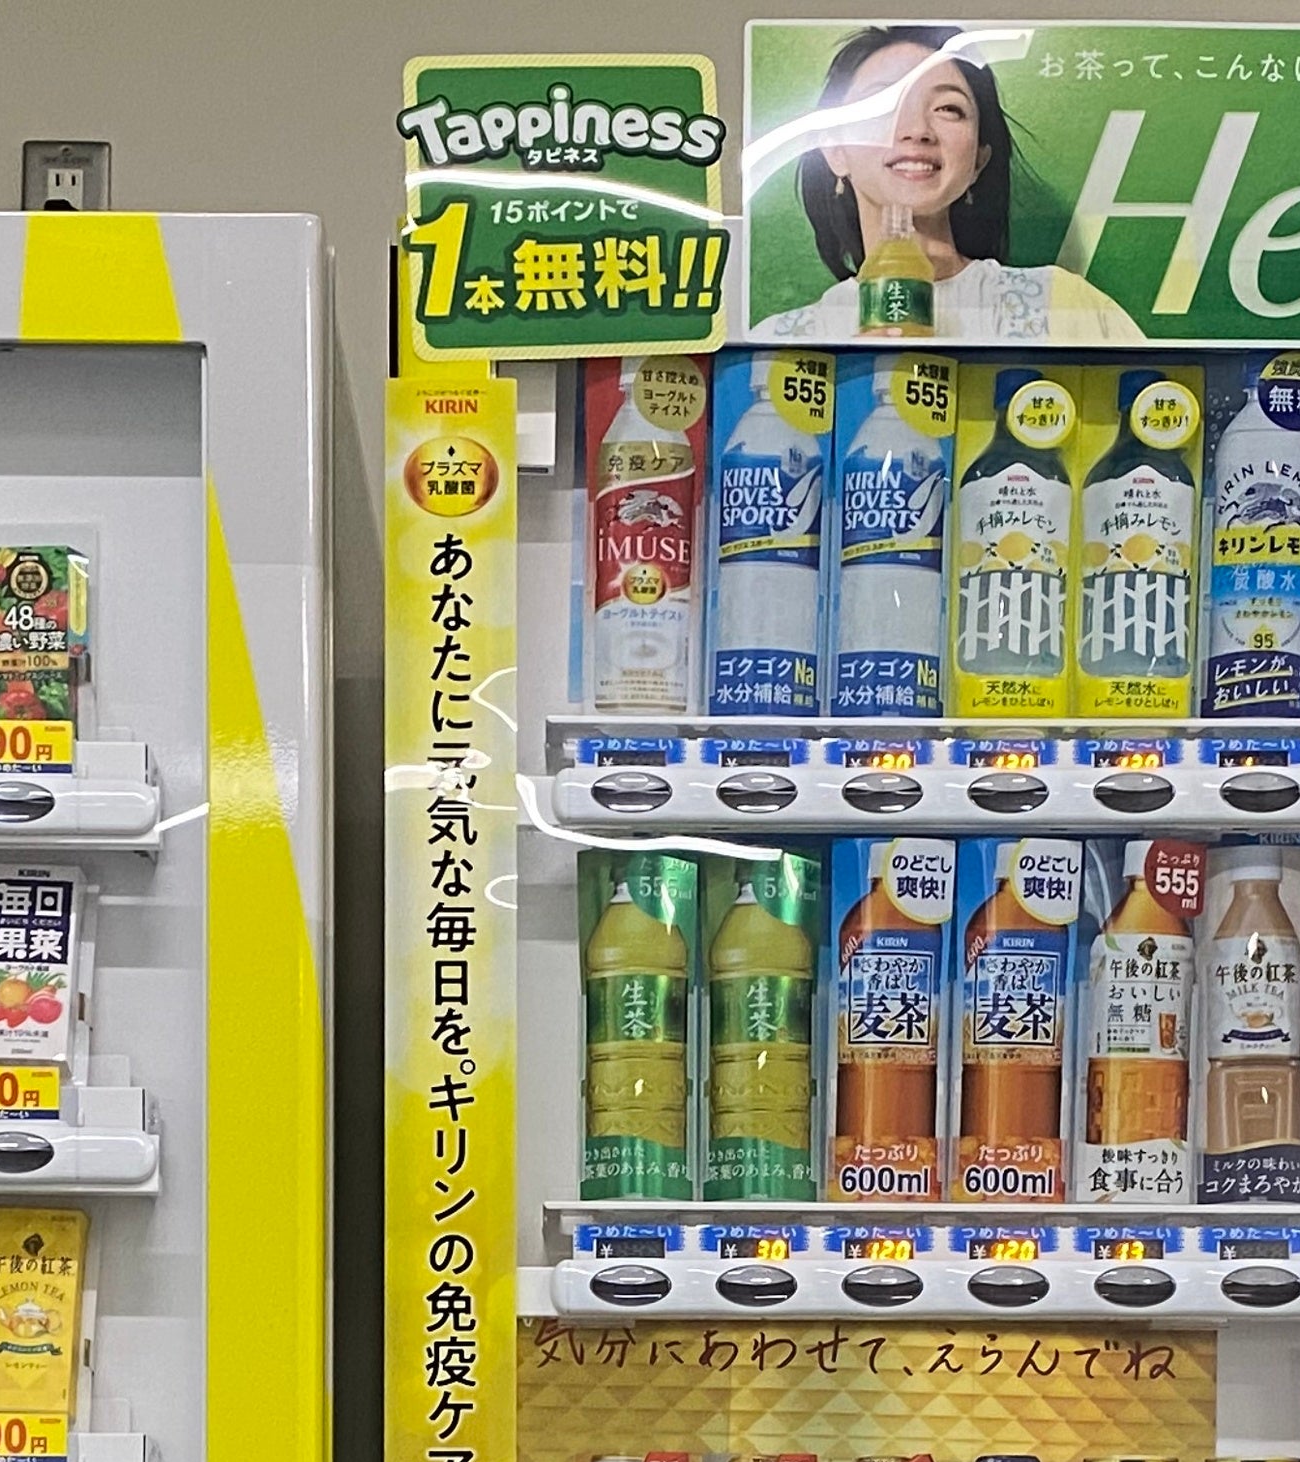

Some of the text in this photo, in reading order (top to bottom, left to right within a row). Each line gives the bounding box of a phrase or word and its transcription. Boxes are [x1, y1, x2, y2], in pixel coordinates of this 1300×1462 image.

[401, 87, 721, 164] Tappiness
[528, 149, 598, 165] タピネス
[491, 200, 639, 223] 15ポイントで
[409, 202, 722, 316] 1本無料!!
[885, 282, 908, 322] 生茶
[783, 377, 826, 406] 555
[425, 400, 477, 413] KIRIN
[420, 461, 482, 476] プラズマ
[607, 454, 685, 473] 免疫ケア
[428, 480, 475, 495] 乳酸菌
[723, 469, 780, 489] KIRIN
[723, 488, 783, 507] LOVES
[722, 507, 800, 528] SPORTS
[599, 529, 690, 563] iMUSE
[1254, 632, 1273, 649] 95
[719, 658, 793, 679] ゴクゴク
[717, 684, 792, 708] 水分補給
[892, 854, 952, 875] のどごし
[1155, 868, 1200, 896] 555
[1110, 960, 1181, 980] 午後の紅茶
[851, 994, 928, 1041] 麦茶
[841, 1167, 929, 1195] 600ml
[1089, 1168, 1184, 1192] 食事に合う
